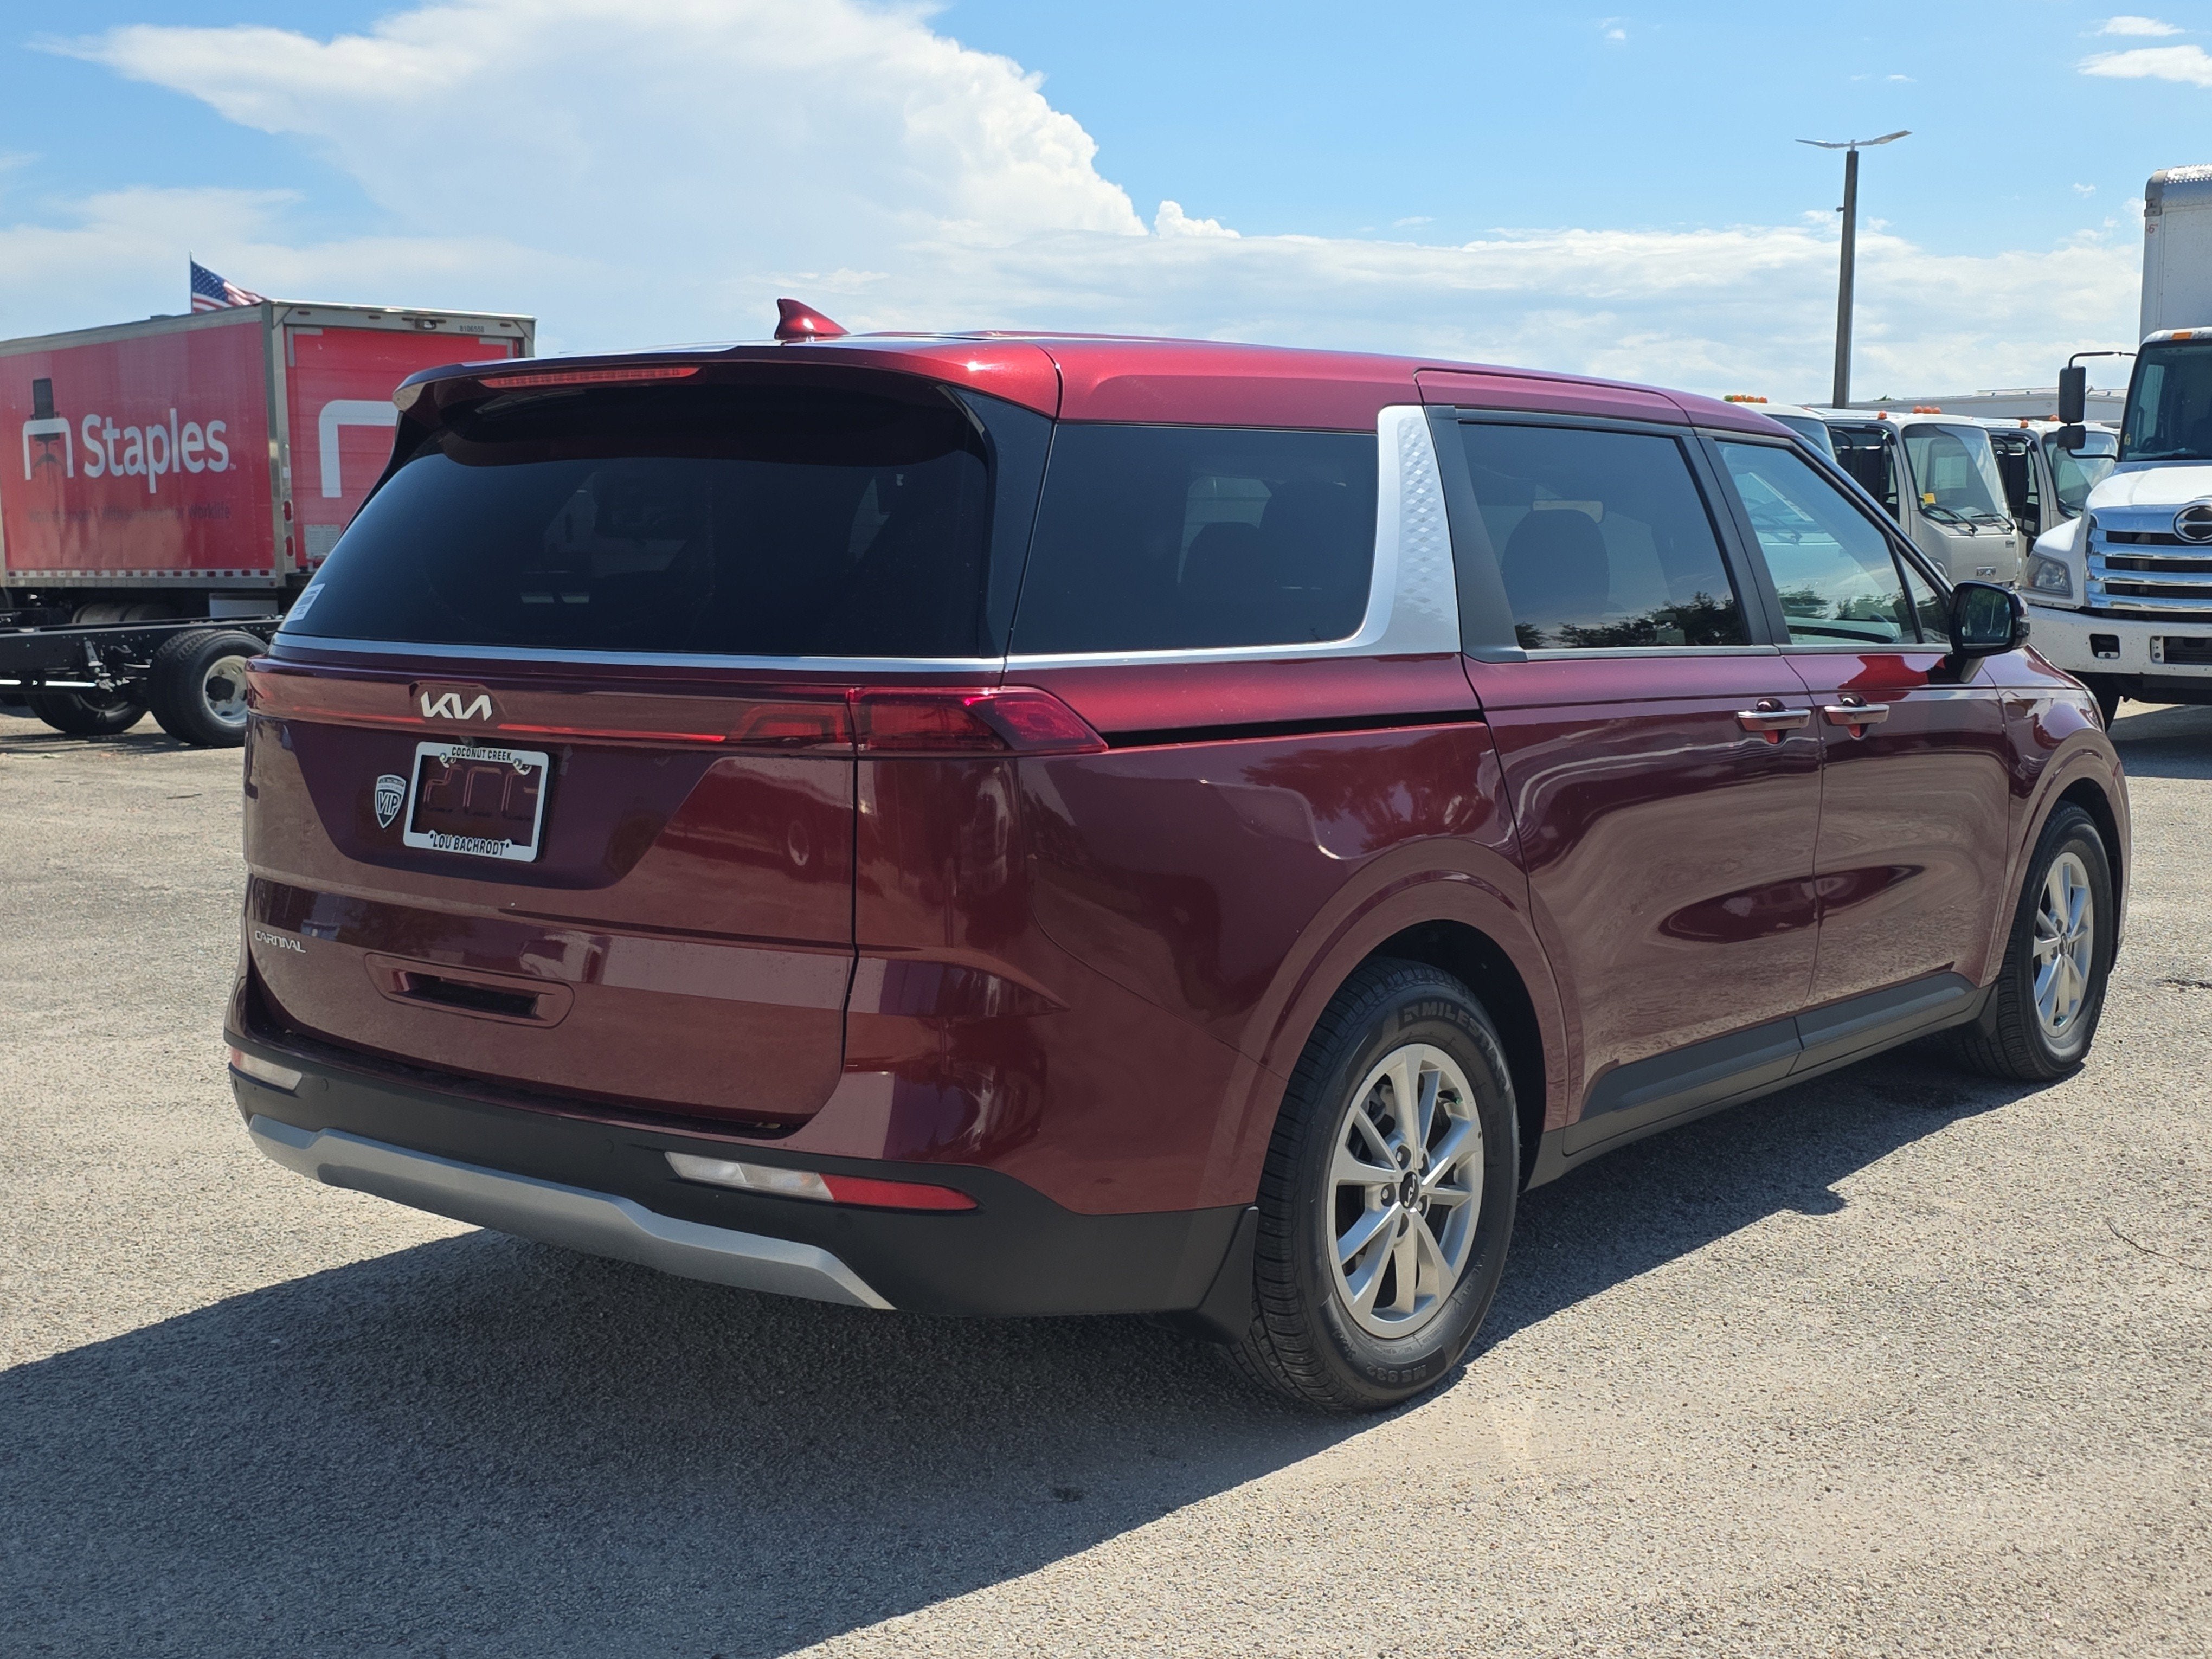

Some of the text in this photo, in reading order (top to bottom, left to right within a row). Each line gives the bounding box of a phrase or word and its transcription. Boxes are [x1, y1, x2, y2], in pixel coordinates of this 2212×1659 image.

[82, 408, 229, 494] Staples
[421, 691, 492, 721] KIA
[452, 747, 511, 761] COCONUT CREEK
[378, 791, 400, 815] VIP
[433, 834, 505, 856] LOU BACHRODT
[255, 930, 306, 953] CARNIVAL
